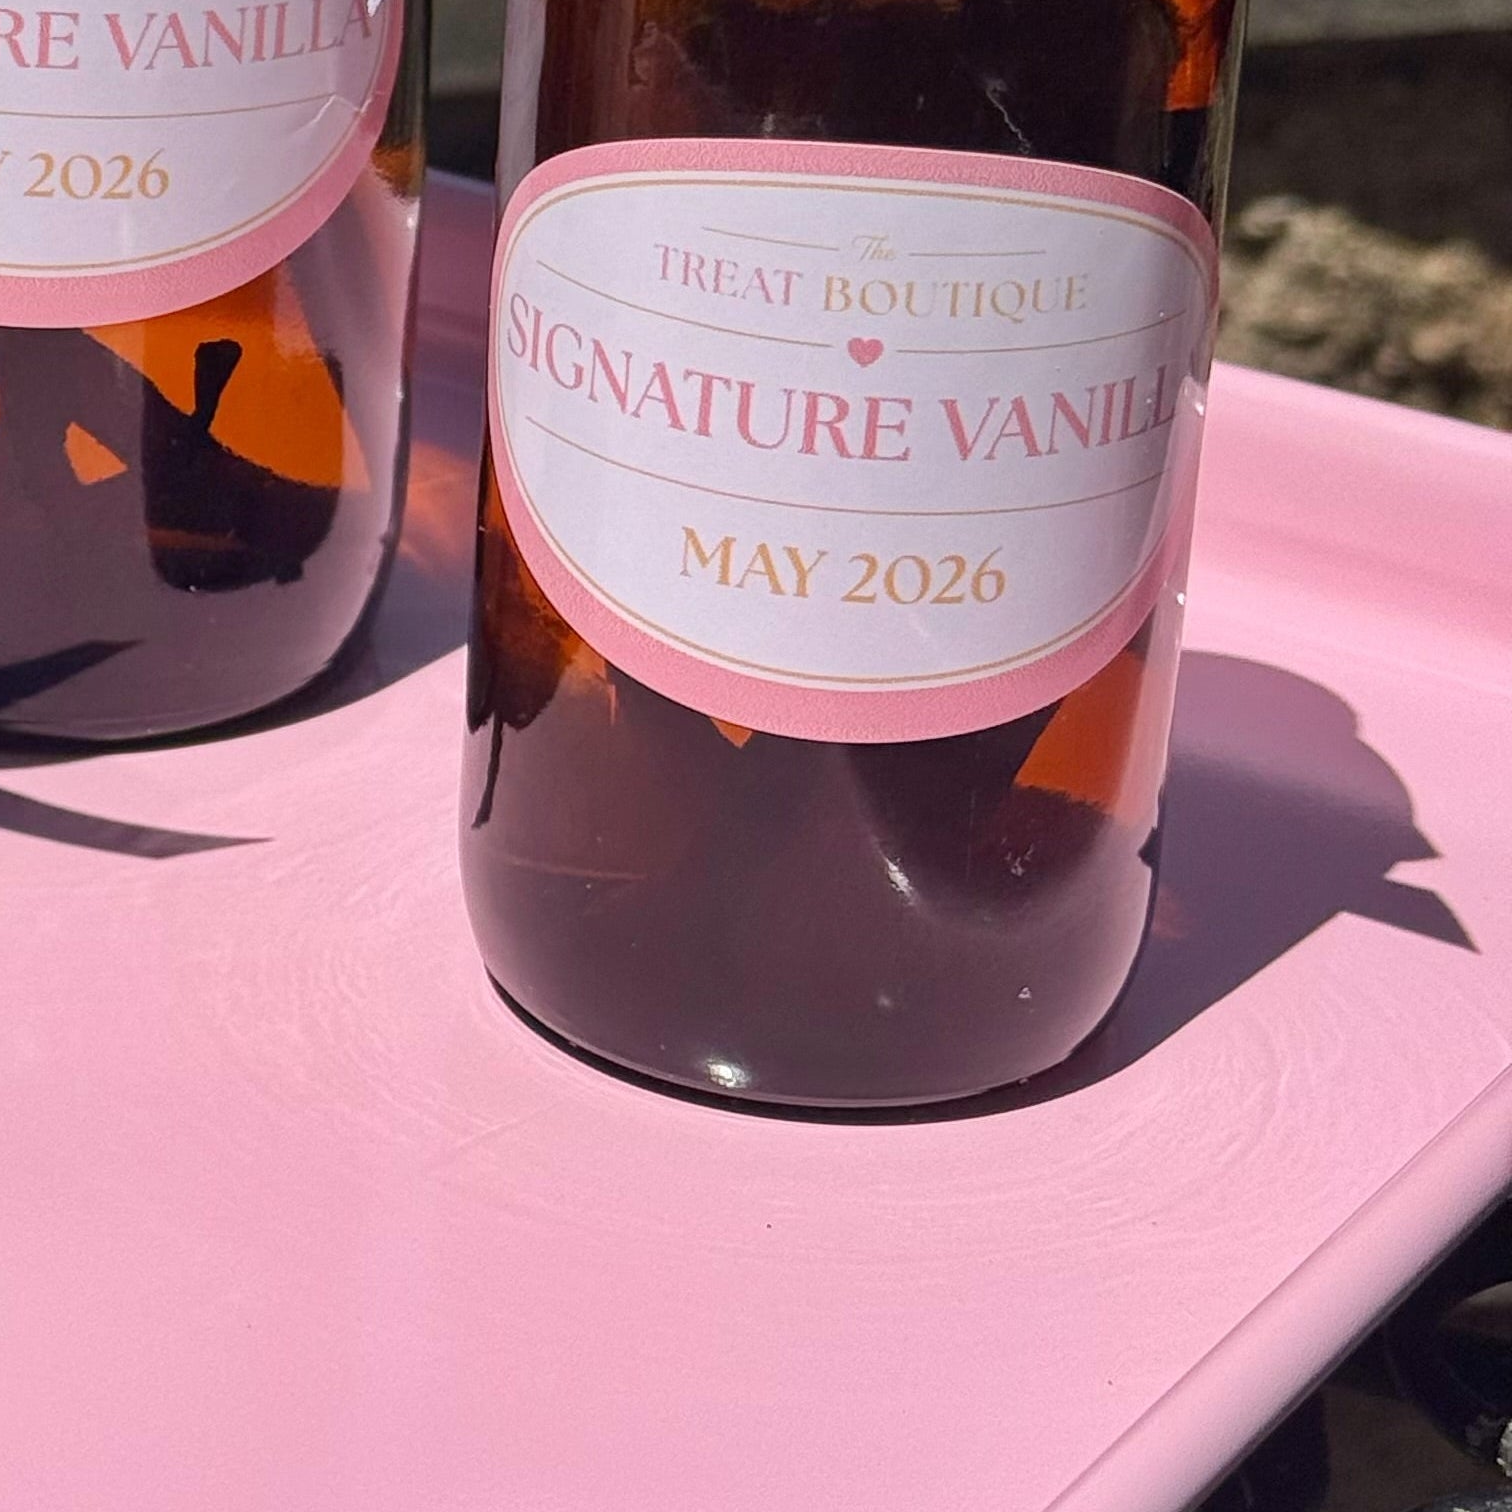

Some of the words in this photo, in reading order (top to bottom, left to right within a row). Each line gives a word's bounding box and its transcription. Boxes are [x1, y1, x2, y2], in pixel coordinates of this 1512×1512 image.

[22, 148, 170, 200] 2026
[653, 243, 802, 306] TREAT
[823, 274, 1088, 324] BOUTIQUE
[506, 292, 911, 461] SIGNATURE
[939, 363, 1176, 462] VANILL
[681, 526, 828, 599] MAY
[841, 545, 1006, 605] 2026
